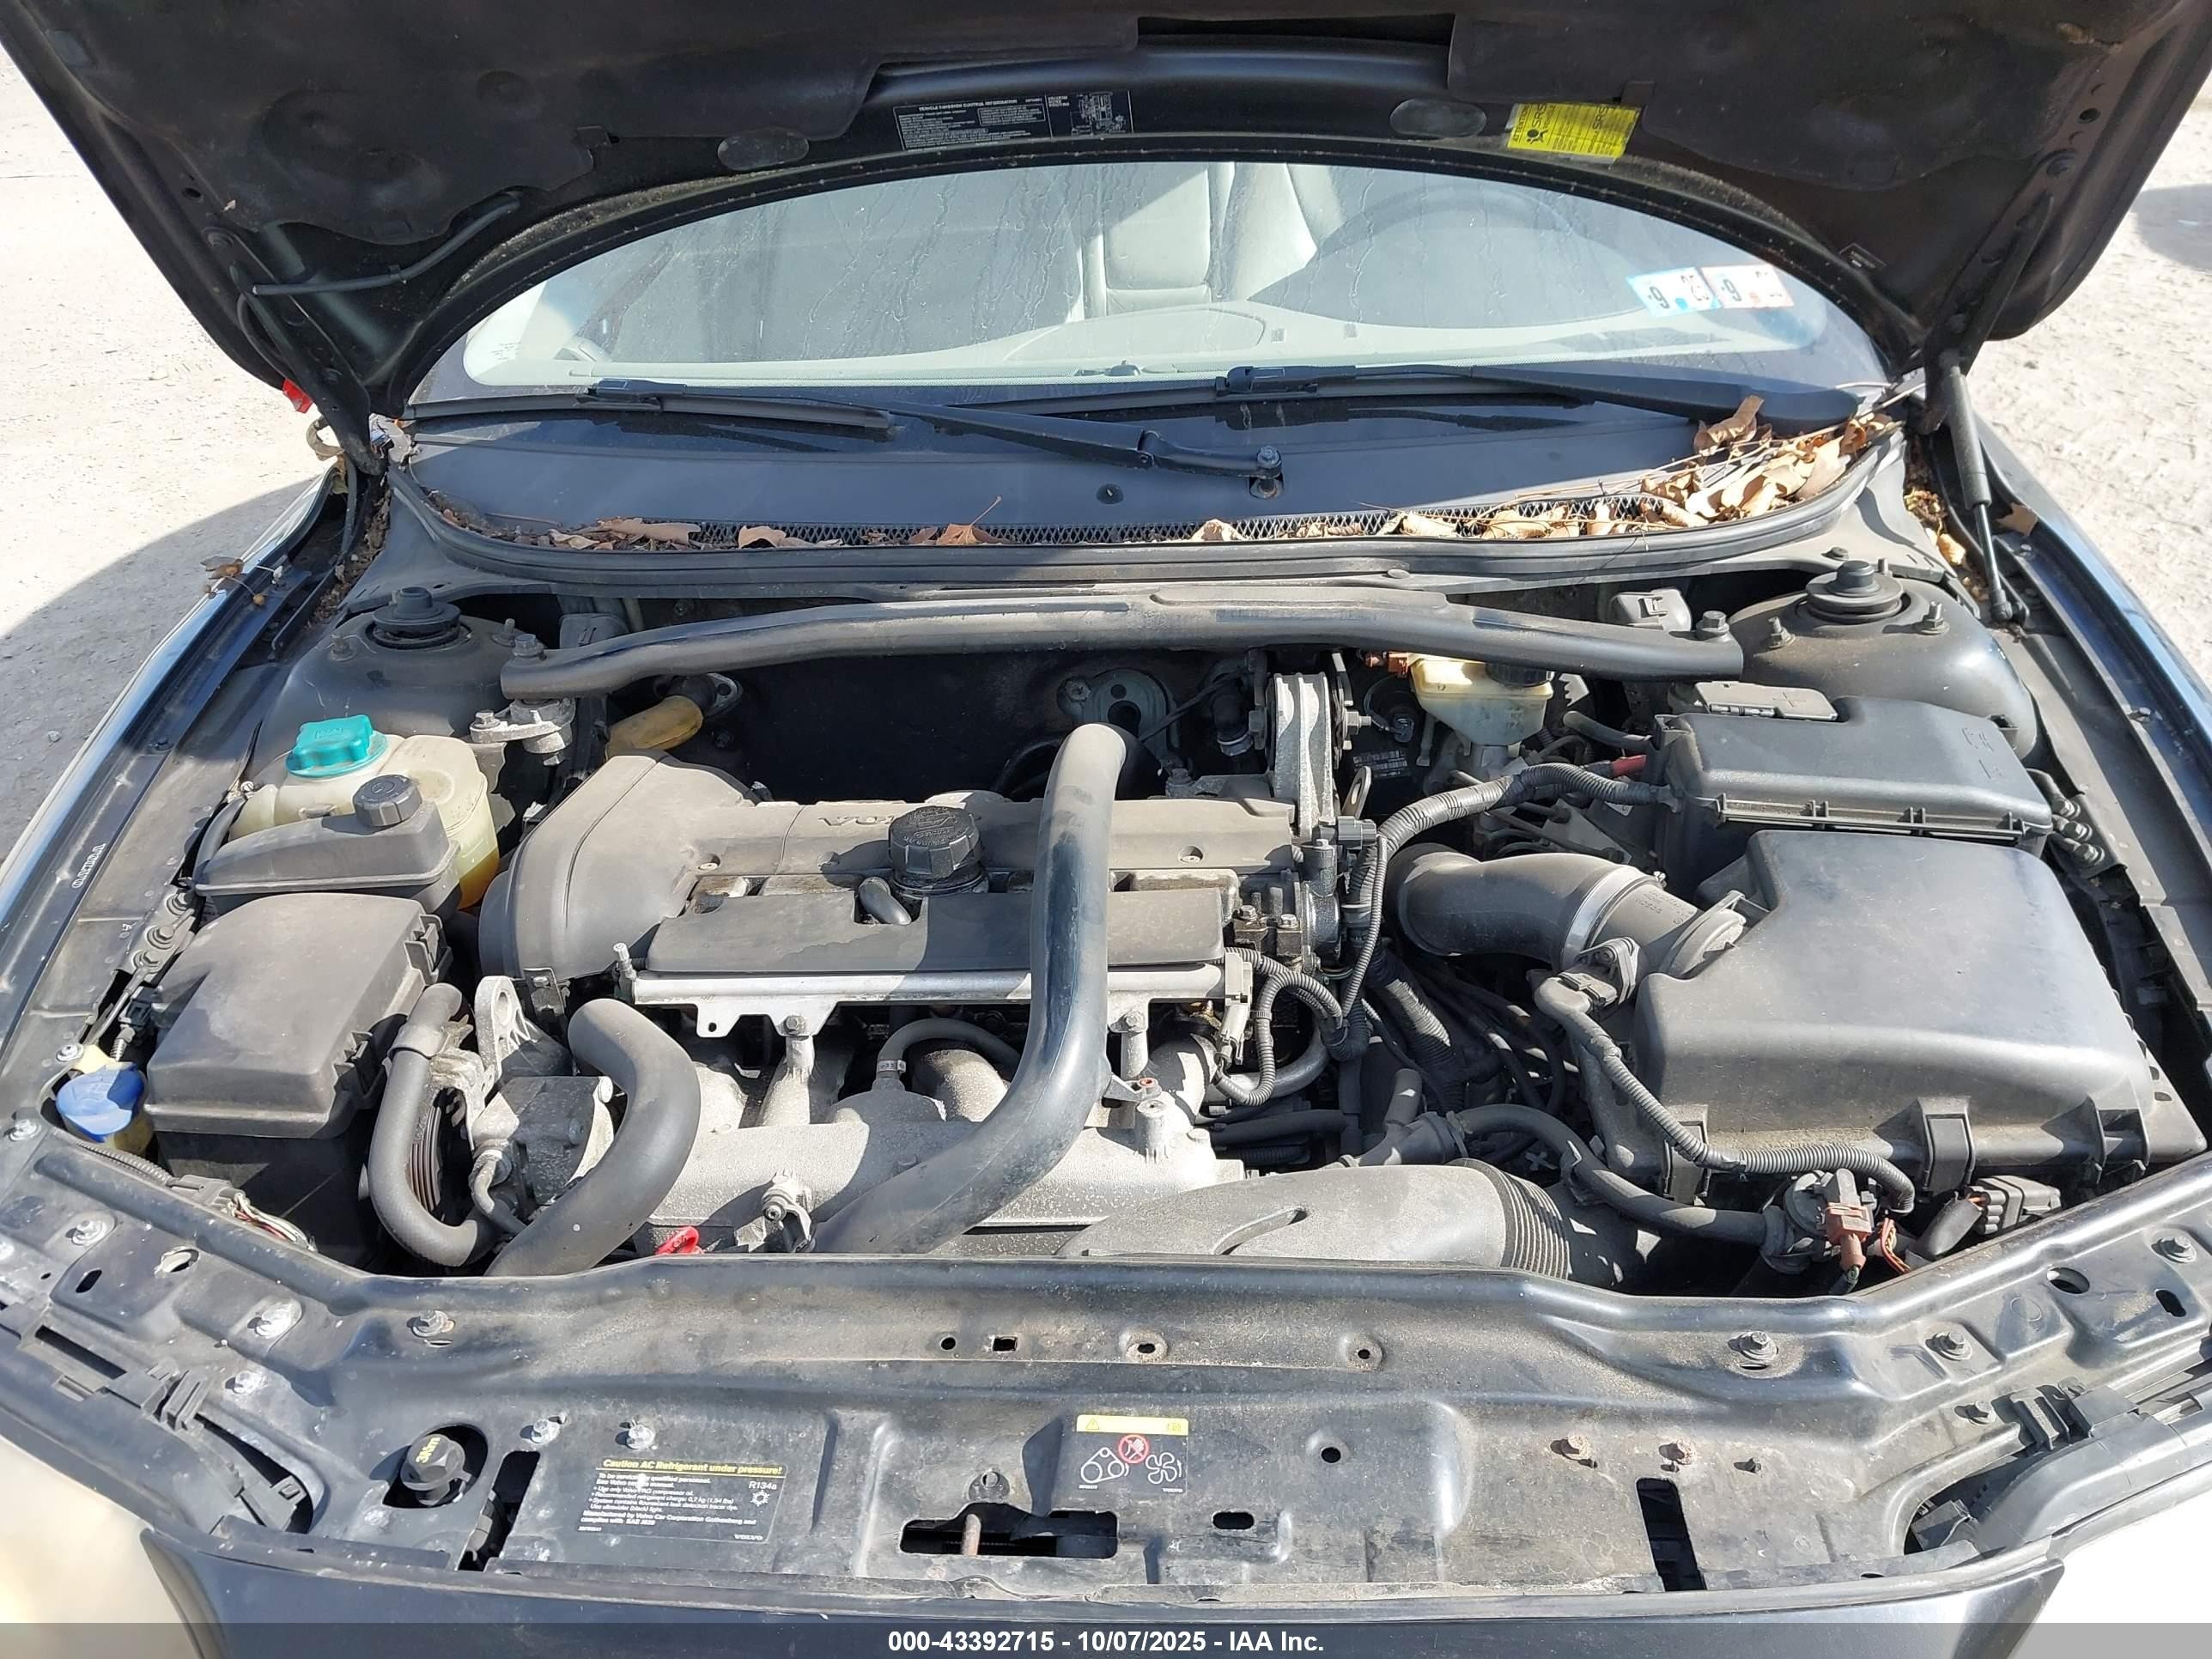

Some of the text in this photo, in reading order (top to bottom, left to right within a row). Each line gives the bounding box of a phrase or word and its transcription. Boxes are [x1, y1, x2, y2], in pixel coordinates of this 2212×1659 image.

[1532, 103, 1547, 128] SRS
[1593, 106, 1609, 130] SRS
[71, 843, 106, 889] VOLVO
[603, 1460, 783, 1475] Caution AC Refrigerant under pressure!
[749, 1480, 777, 1490] R134a
